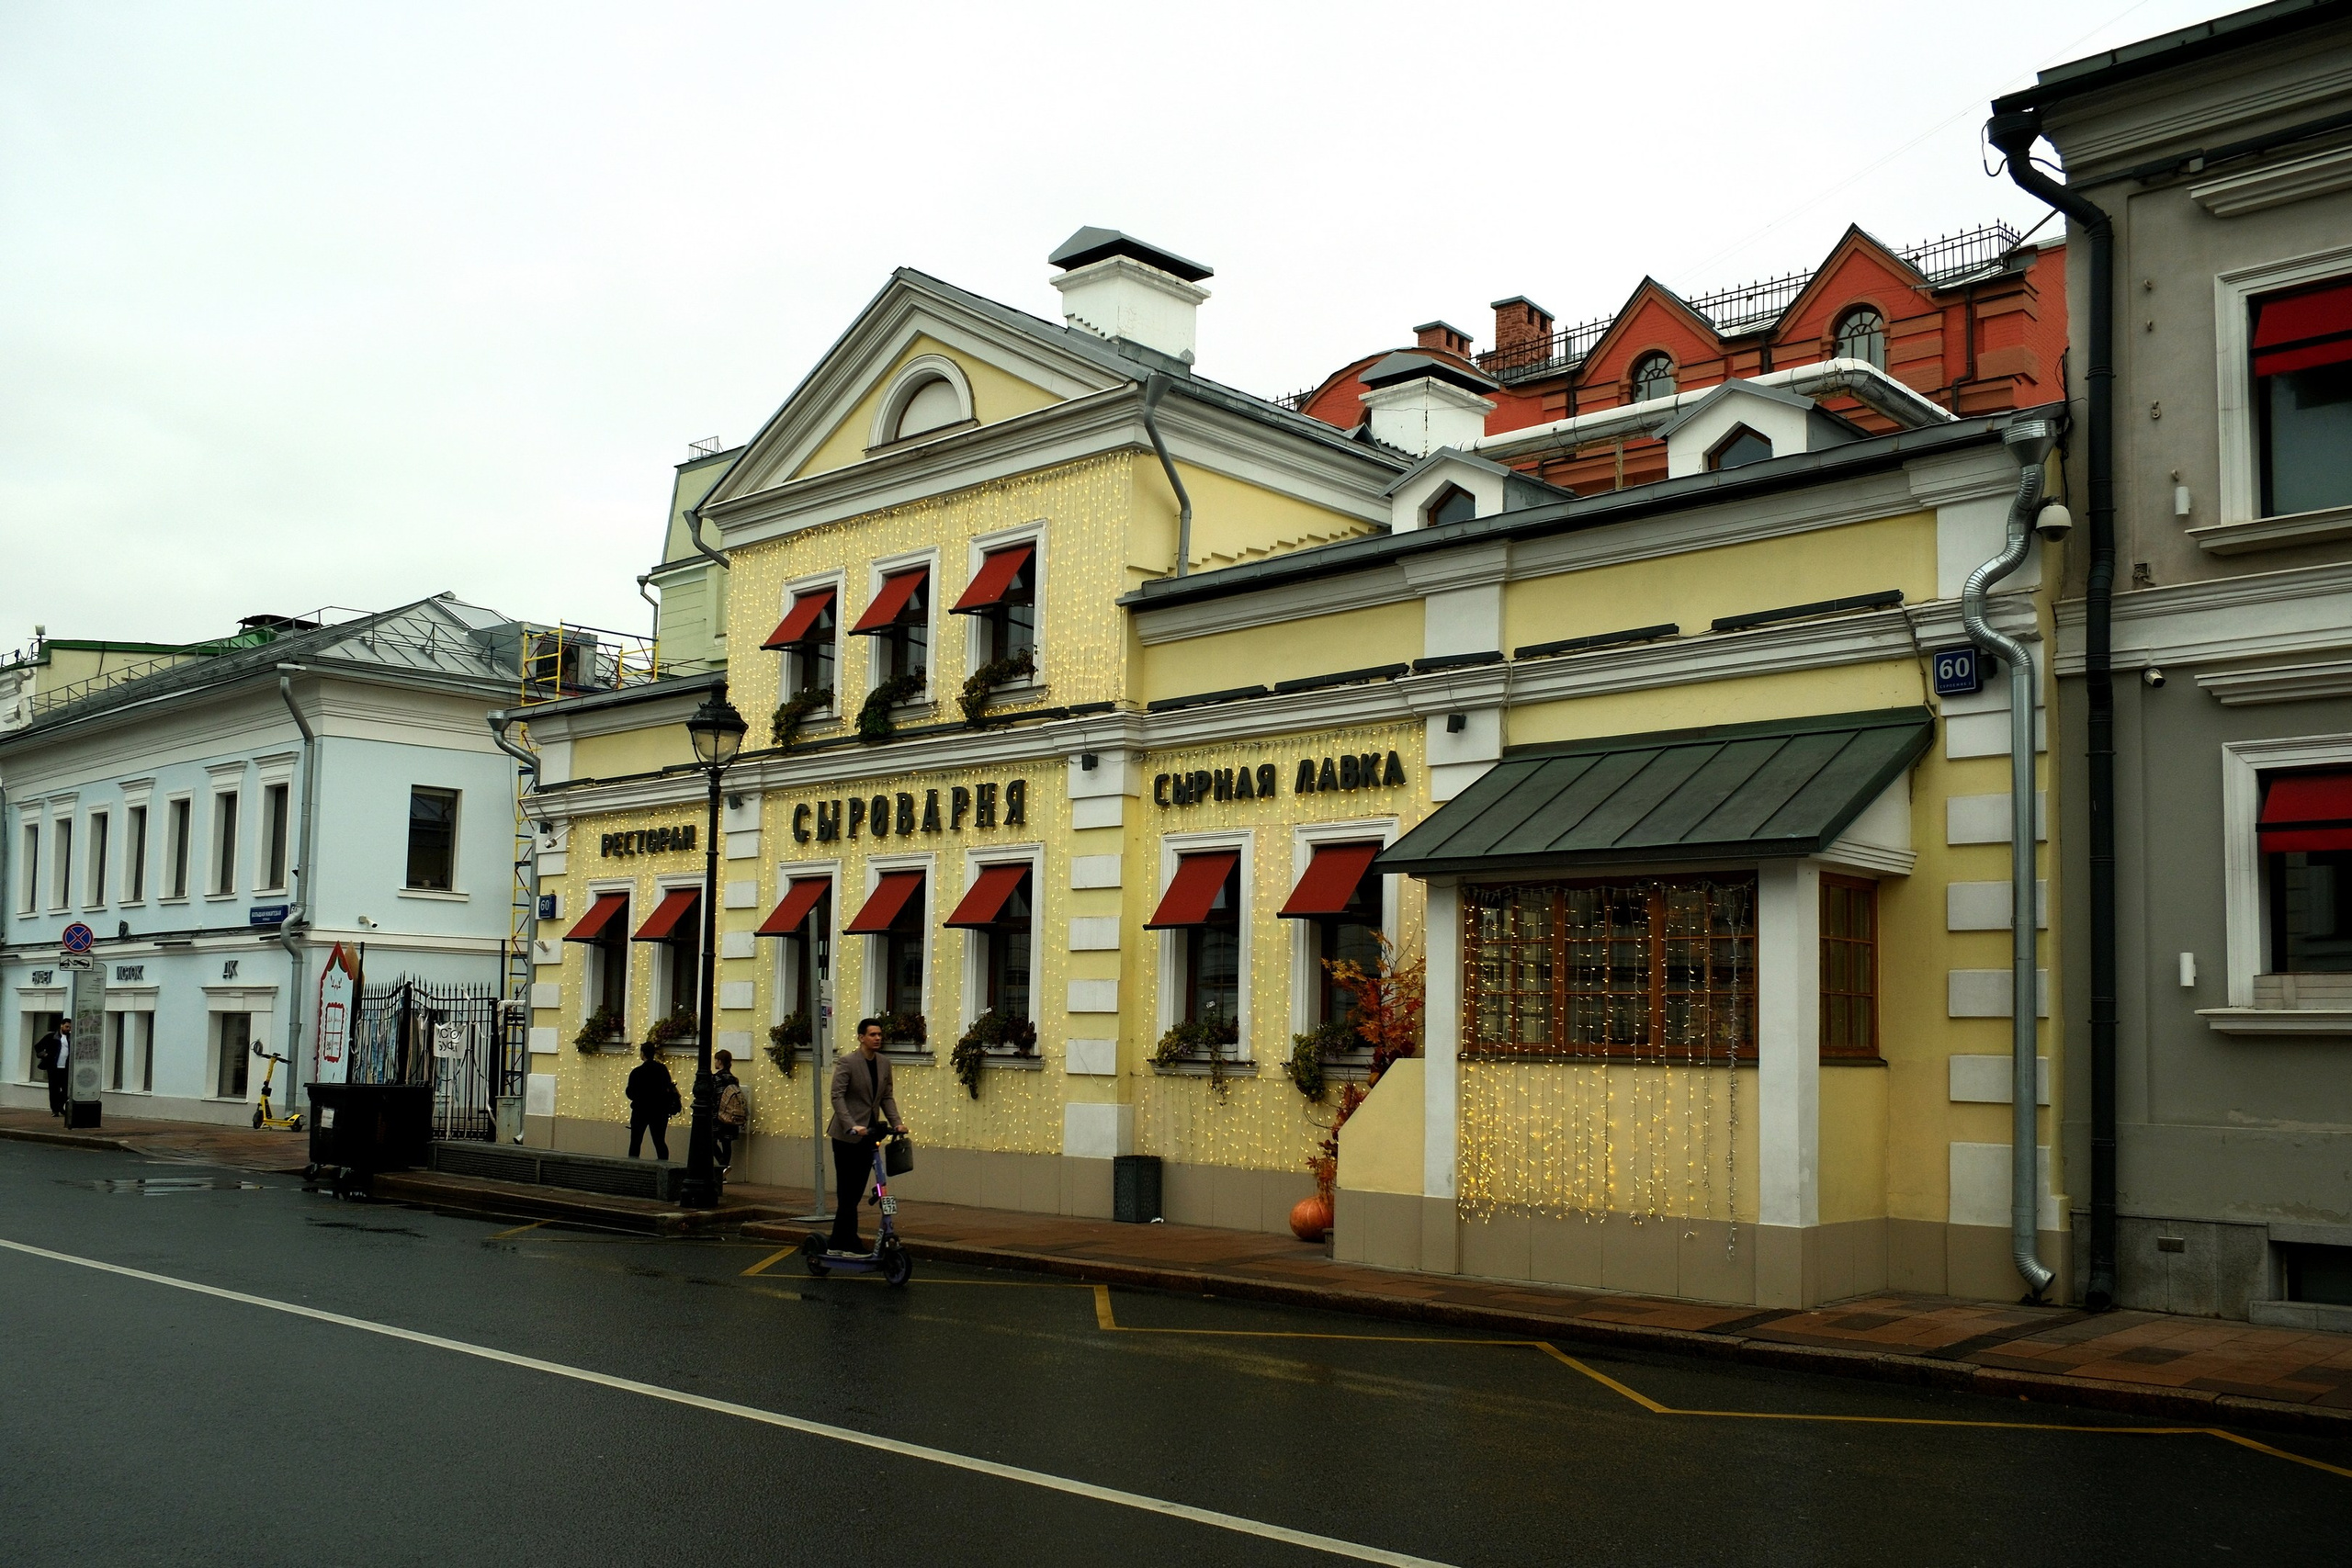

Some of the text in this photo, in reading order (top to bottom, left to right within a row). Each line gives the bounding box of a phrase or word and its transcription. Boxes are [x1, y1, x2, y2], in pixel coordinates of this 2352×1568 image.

[1939, 657, 1970, 680] 60
[1154, 750, 1407, 806] СЫРНАЯ ЛАВКА
[793, 779, 1026, 842] СЫРОВАРНЯ
[601, 825, 695, 857] РЕСТОРАН
[540, 899, 549, 911] 60
[32, 970, 53, 984] БУФЕТ
[117, 965, 144, 981] ИСТОК
[222, 960, 239, 979] ДК
